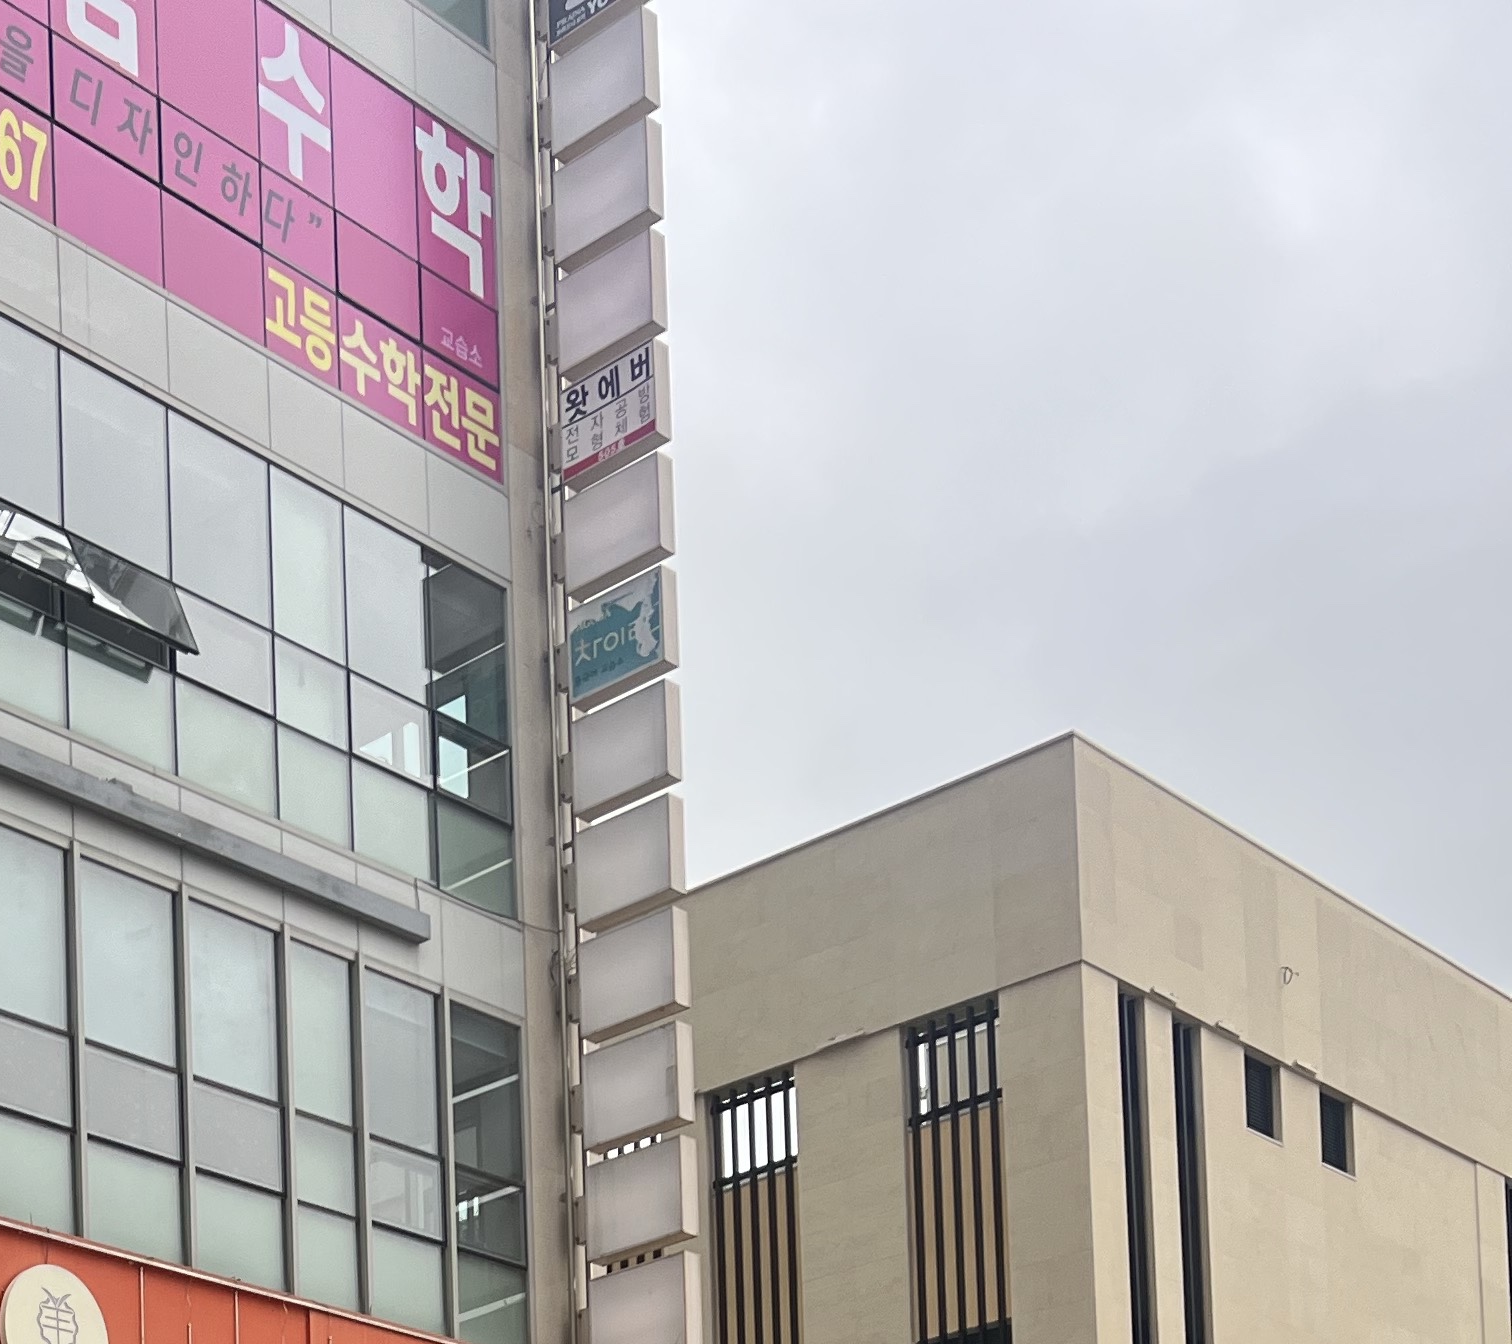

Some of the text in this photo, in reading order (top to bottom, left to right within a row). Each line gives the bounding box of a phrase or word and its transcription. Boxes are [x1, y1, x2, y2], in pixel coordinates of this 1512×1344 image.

[266, 267, 500, 470] 고등수학전문
[441, 327, 483, 368] 교습소
[565, 347, 650, 422] 왓에버
